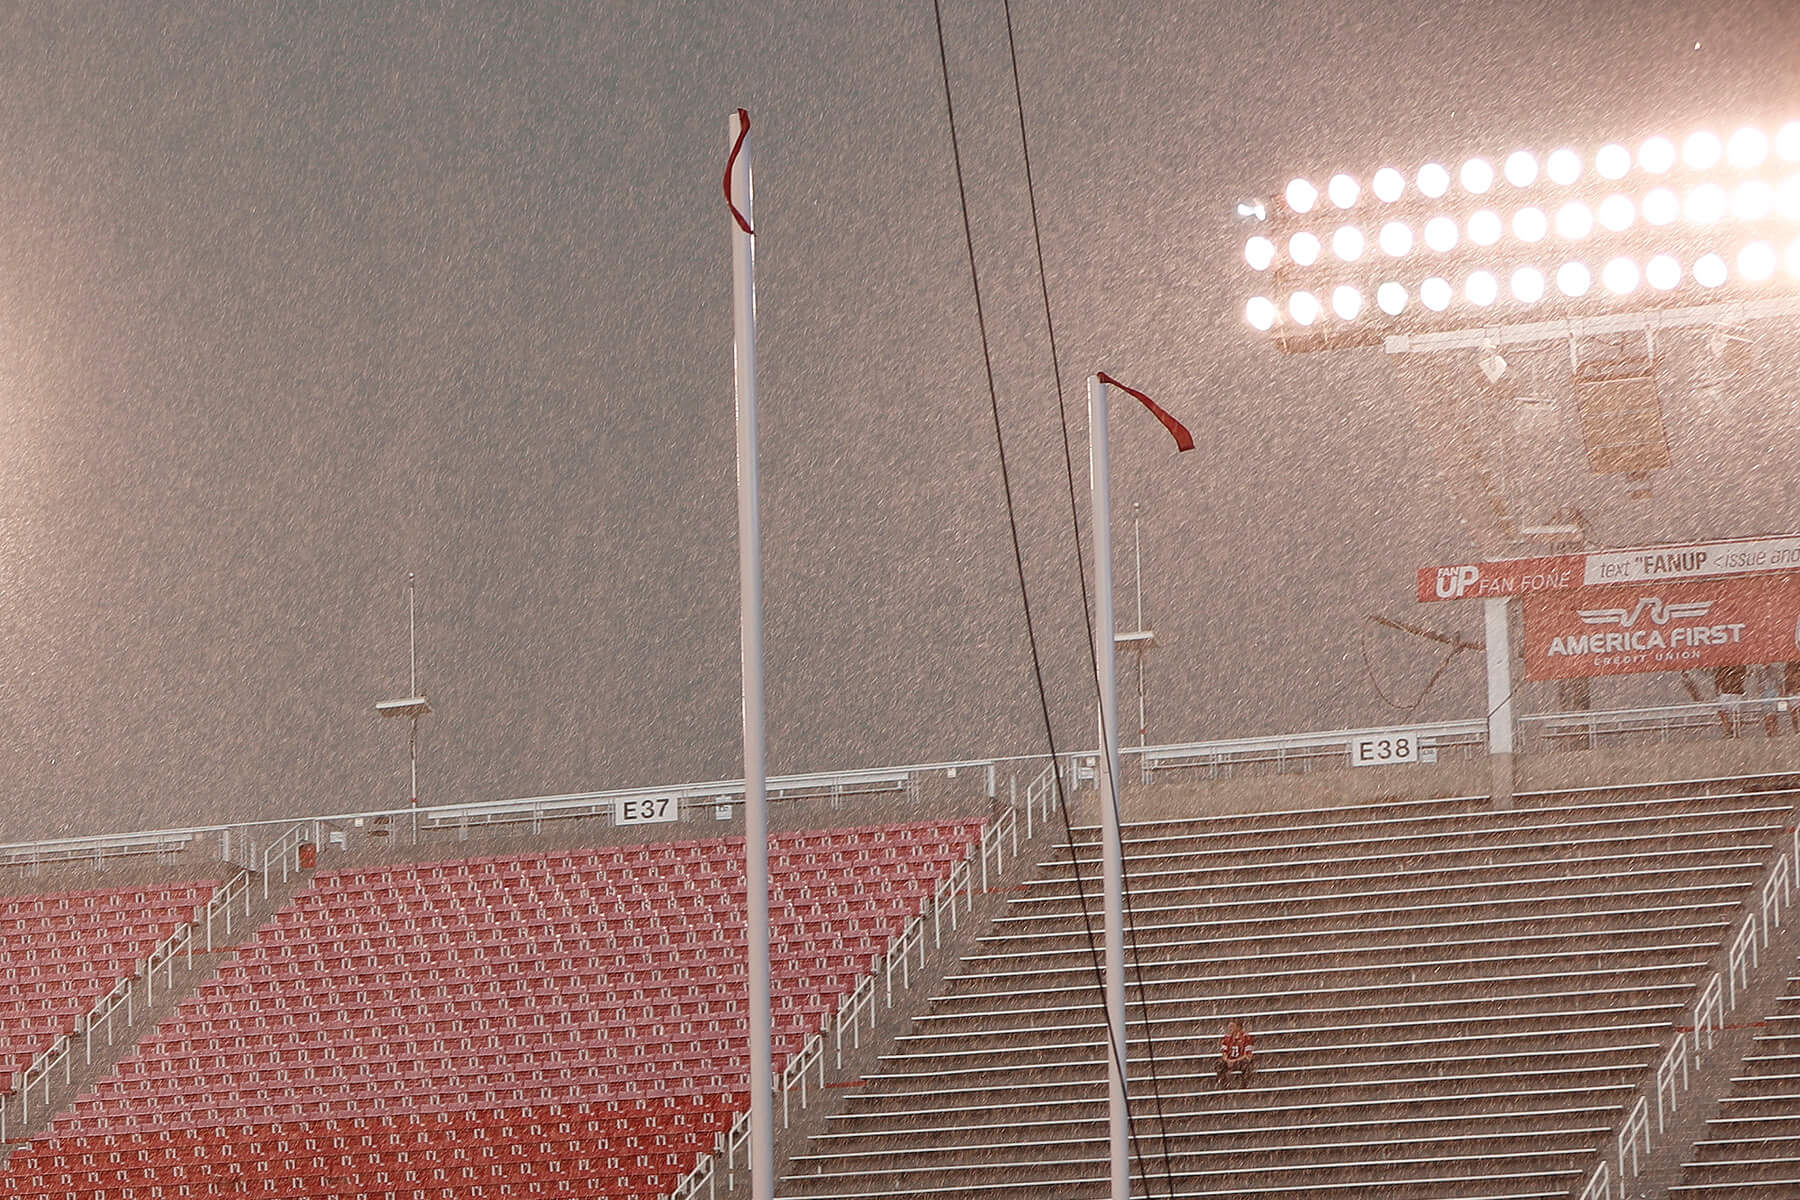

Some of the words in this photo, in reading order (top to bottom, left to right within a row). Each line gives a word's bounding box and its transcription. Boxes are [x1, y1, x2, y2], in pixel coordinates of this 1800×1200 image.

[1436, 565, 1479, 598] UP
[1547, 630, 1666, 657] AMERICA
[1671, 623, 1747, 649] FIRST
[1358, 738, 1411, 762] E38
[624, 798, 670, 820] E37
